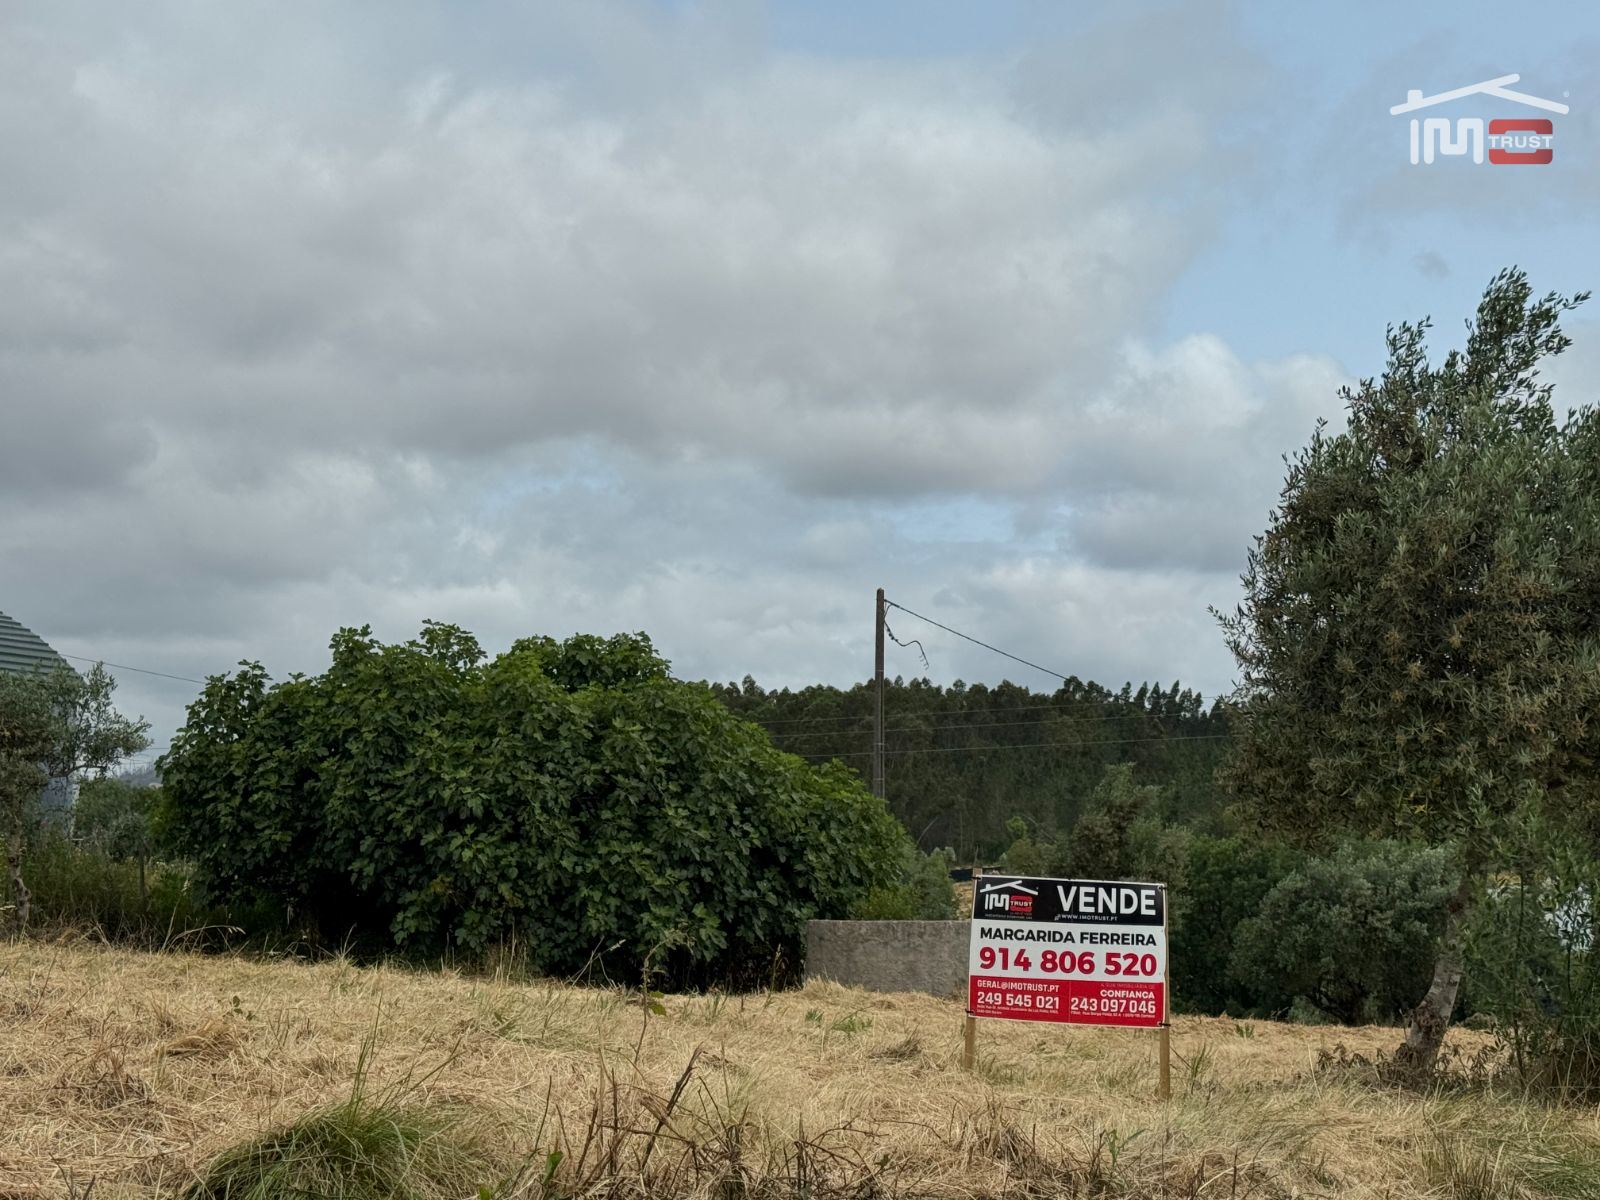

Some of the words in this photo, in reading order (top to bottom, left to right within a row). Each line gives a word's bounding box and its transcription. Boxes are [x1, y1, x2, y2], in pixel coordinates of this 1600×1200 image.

[1057, 885, 1156, 915] VENDE
[980, 927, 1075, 944] MARGARIDA
[1080, 932, 1157, 946] FERREIRA
[979, 946, 1032, 971] 914
[1040, 950, 1095, 975] 806
[1104, 952, 1157, 976] 520
[977, 980, 1060, 993] GERAL@IMOTRUST.PT
[977, 991, 1002, 1005] 249
[1005, 993, 1032, 1007] 545
[1036, 996, 1060, 1009] 021
[1070, 997, 1098, 1011] 243
[1100, 999, 1127, 1012] 097
[1129, 1000, 1156, 1014] 046
